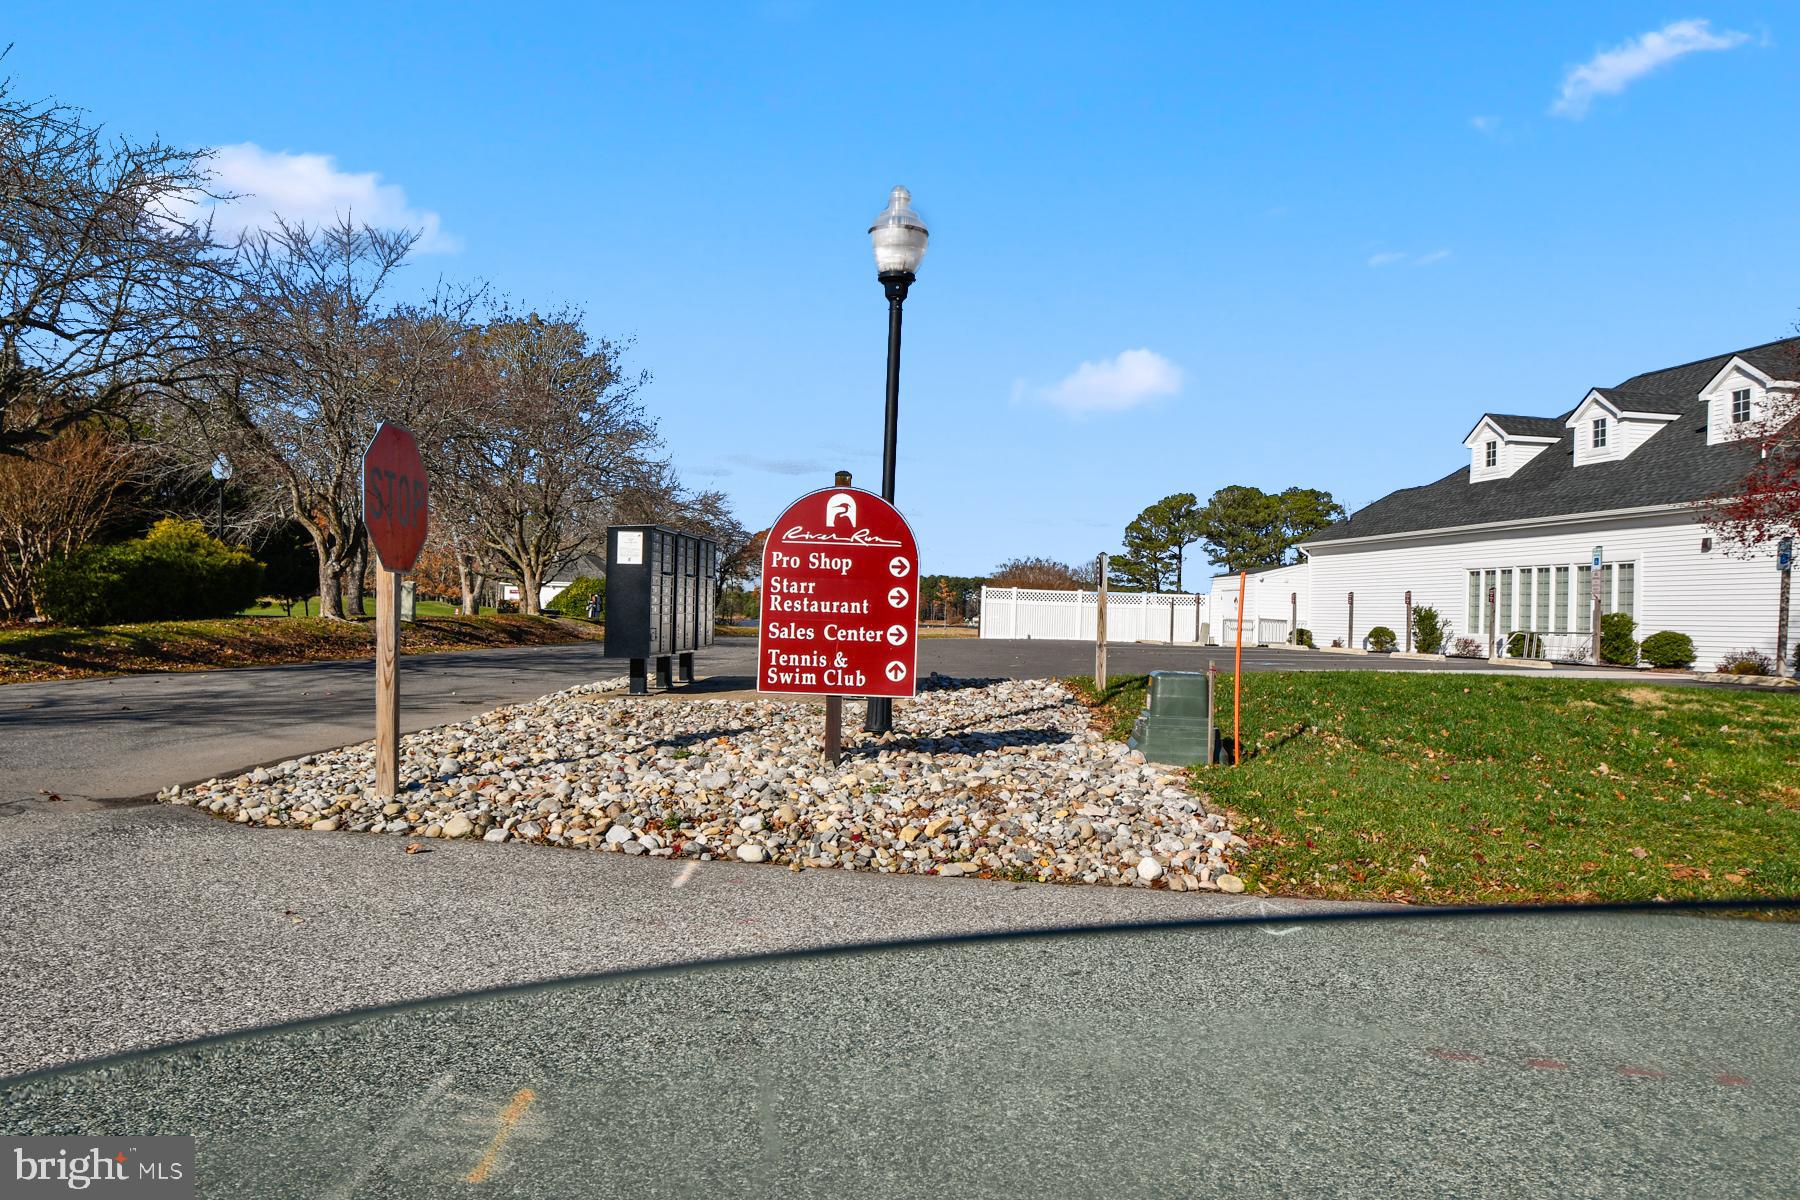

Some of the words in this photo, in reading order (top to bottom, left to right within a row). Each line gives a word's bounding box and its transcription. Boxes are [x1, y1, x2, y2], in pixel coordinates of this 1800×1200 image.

[370, 467, 424, 527] STOP
[771, 552, 800, 568] Pro
[809, 553, 852, 575] Shop
[770, 576, 816, 594] Starr
[770, 595, 869, 614] Restaurant
[768, 623, 815, 639] Sales
[823, 624, 884, 642] Center
[768, 650, 827, 667] Tennis
[833, 651, 848, 668] &
[767, 667, 817, 684] Swim
[823, 669, 866, 687] Club
